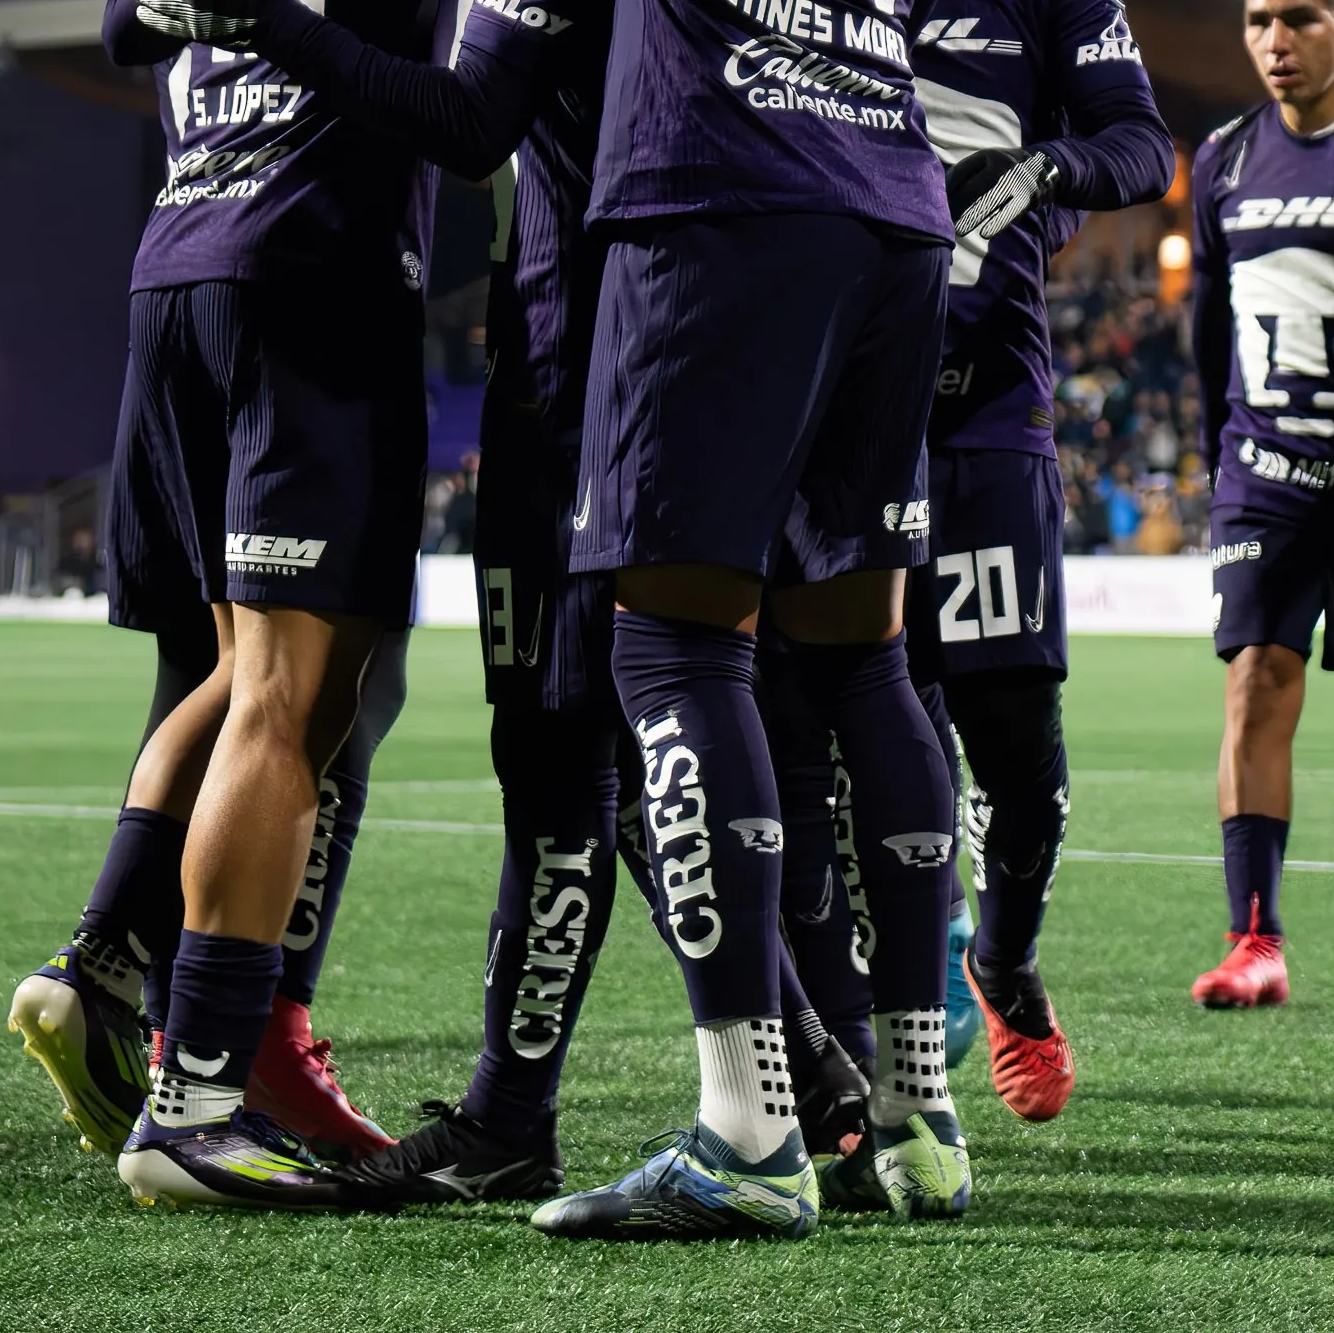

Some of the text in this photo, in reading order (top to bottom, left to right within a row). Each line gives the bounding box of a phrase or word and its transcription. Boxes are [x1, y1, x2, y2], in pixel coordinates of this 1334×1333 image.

[192, 74, 302, 127] S. LÓPEZ
[747, 85, 907, 131] caliente.mx
[225, 532, 328, 567] KEM
[936, 545, 1022, 643] 20
[507, 835, 595, 1060] CREST
